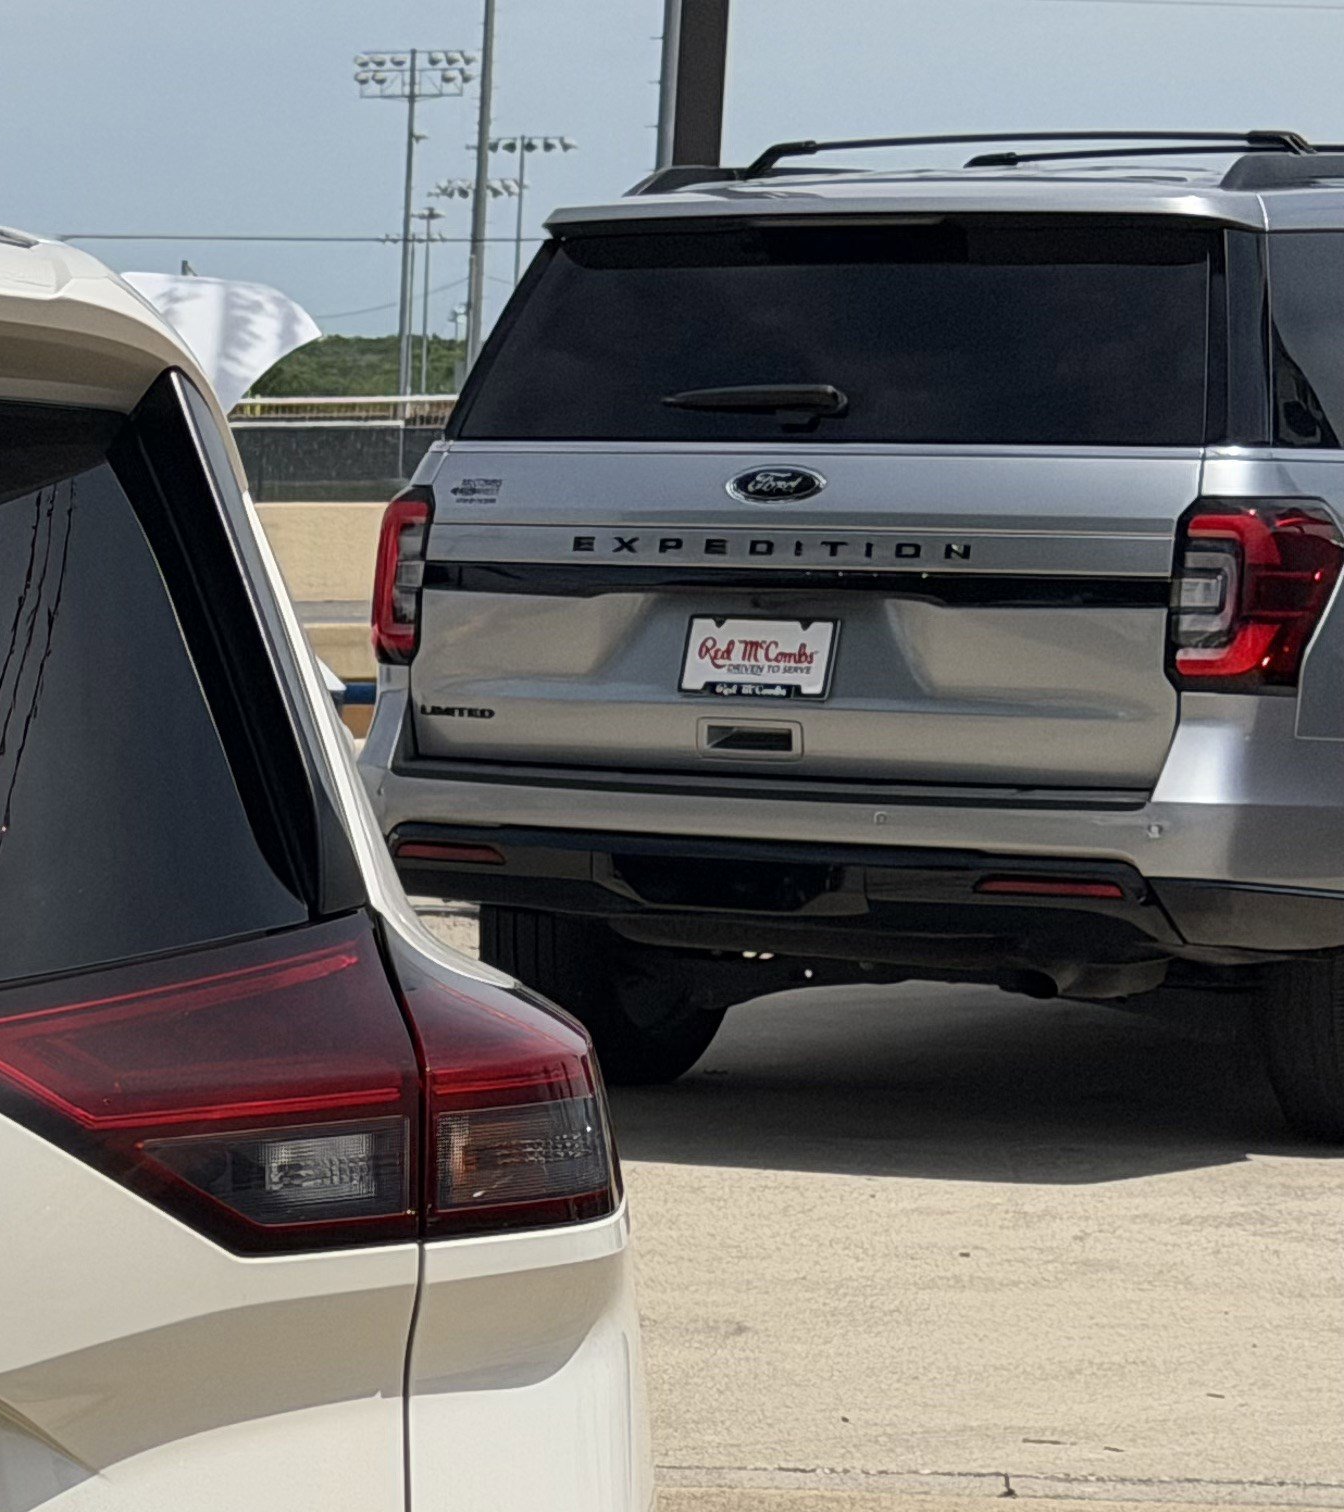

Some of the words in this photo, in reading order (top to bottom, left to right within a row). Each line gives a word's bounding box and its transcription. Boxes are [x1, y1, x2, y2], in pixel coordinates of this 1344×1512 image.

[748, 472, 800, 493] Ford
[572, 536, 972, 560] EXPEDITION
[698, 636, 735, 669] Red
[738, 639, 814, 664] McCombs
[767, 665, 780, 674] TO
